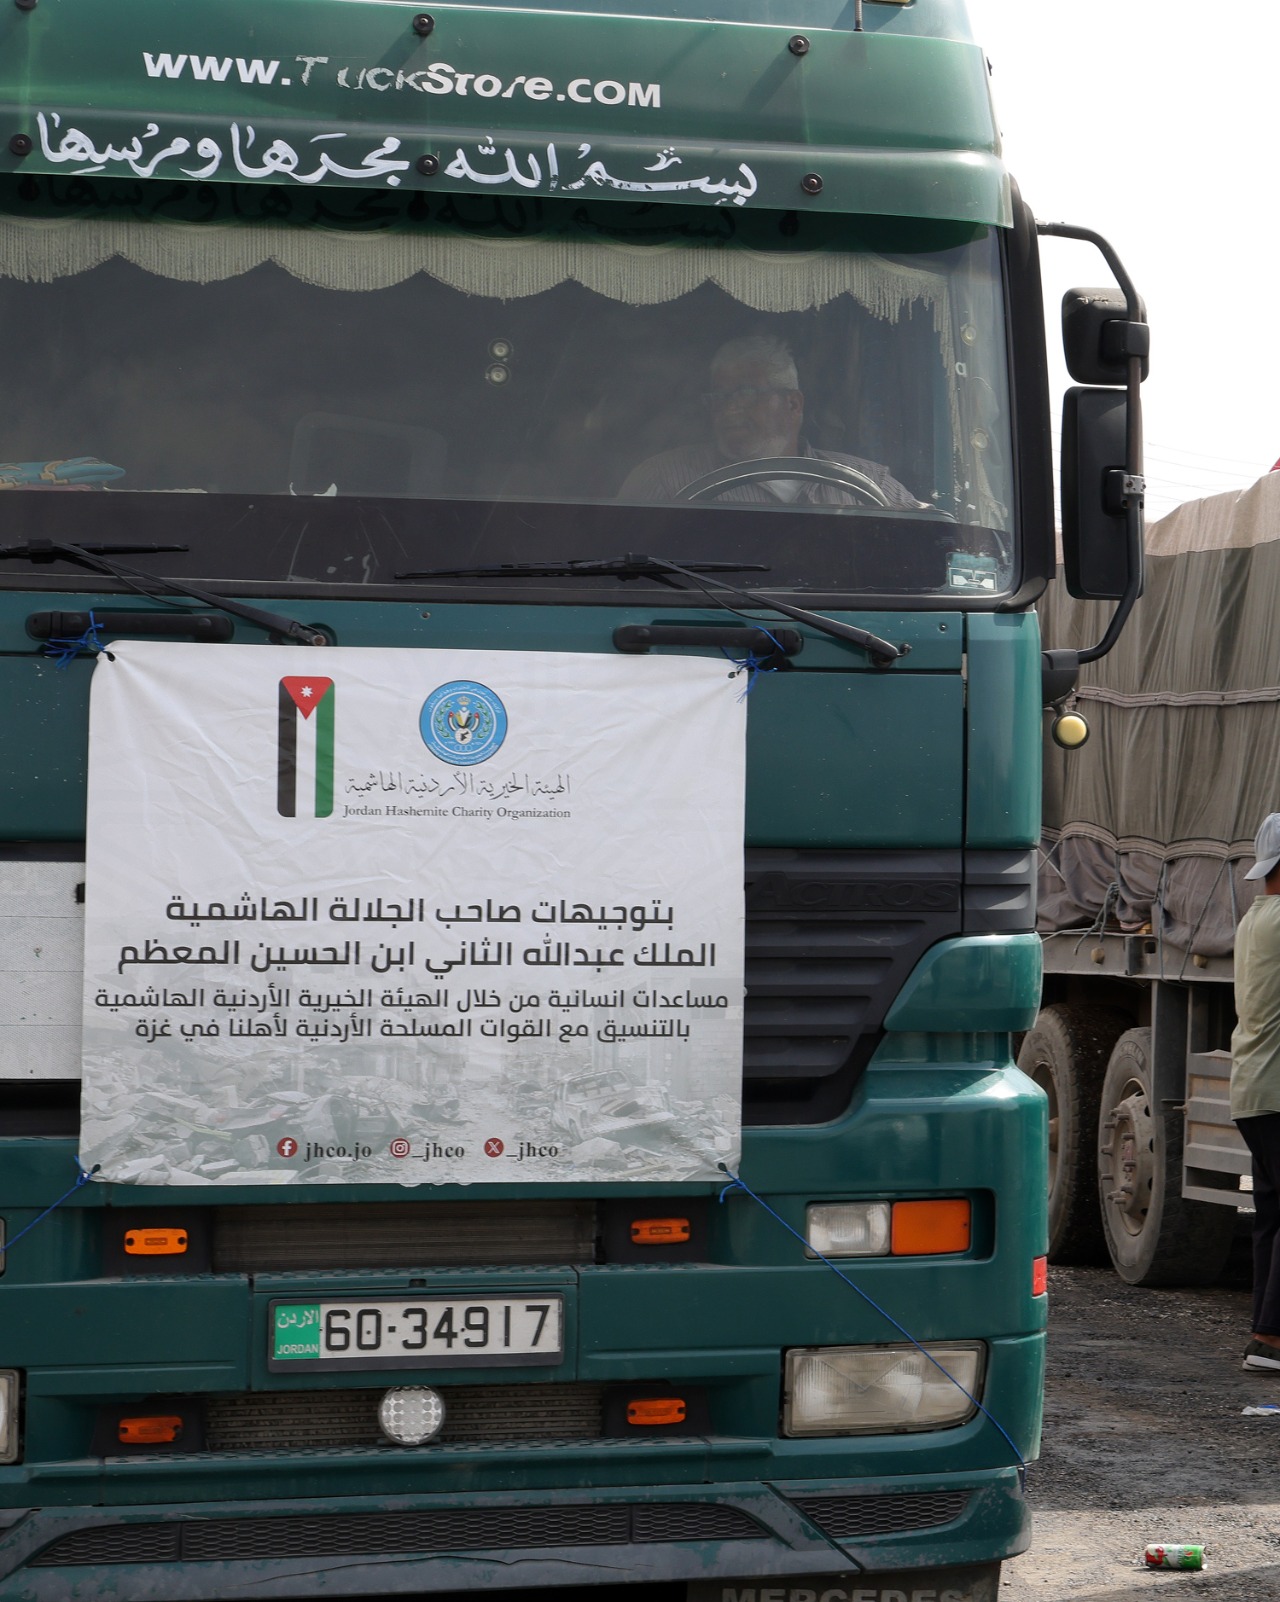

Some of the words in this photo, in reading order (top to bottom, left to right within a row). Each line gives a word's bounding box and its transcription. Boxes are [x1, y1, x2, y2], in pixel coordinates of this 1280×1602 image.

[345, 770, 402, 798] الهاشمية
[476, 772, 529, 801] الخيرية
[532, 772, 571, 801] الهيئة
[342, 804, 382, 819] Jordan
[385, 805, 449, 817] Hashemite
[451, 806, 494, 821] Charity
[496, 806, 572, 821] Organization
[165, 891, 319, 928] الهاشمية
[328, 896, 425, 929] الجلالة
[434, 898, 522, 930] صاحب
[530, 899, 674, 932] بتوجيهات
[117, 938, 240, 975] المعظم
[250, 940, 361, 973] الحسين
[370, 940, 415, 974] ابن
[424, 936, 513, 981] الثاني
[522, 932, 625, 974] عبدالله
[633, 942, 716, 967] الملك
[94, 985, 205, 1013] الهاشمية
[212, 982, 291, 1013] الأردنية
[298, 988, 373, 1013] الخيرية
[380, 986, 449, 1013] الهيئة
[456, 988, 502, 1014] خلال
[508, 993, 541, 1013] من
[547, 989, 625, 1013] انسانية
[632, 989, 729, 1009] مساعدات
[134, 1018, 173, 1044] غزة
[179, 1018, 221, 1043] في
[228, 1012, 288, 1038] لأهلنا
[295, 1012, 372, 1043] الأردنية
[379, 1018, 473, 1038] المسلحة
[479, 1018, 552, 1044] القوات
[558, 1023, 589, 1044] مع
[596, 1018, 690, 1044] بالتنسيق
[303, 1142, 373, 1162] jhco.jo
[411, 1142, 466, 1162] _jhco
[506, 1142, 559, 1162] _jhco
[276, 1308, 320, 1329] الاردن
[276, 1343, 320, 1355] JORDAN
